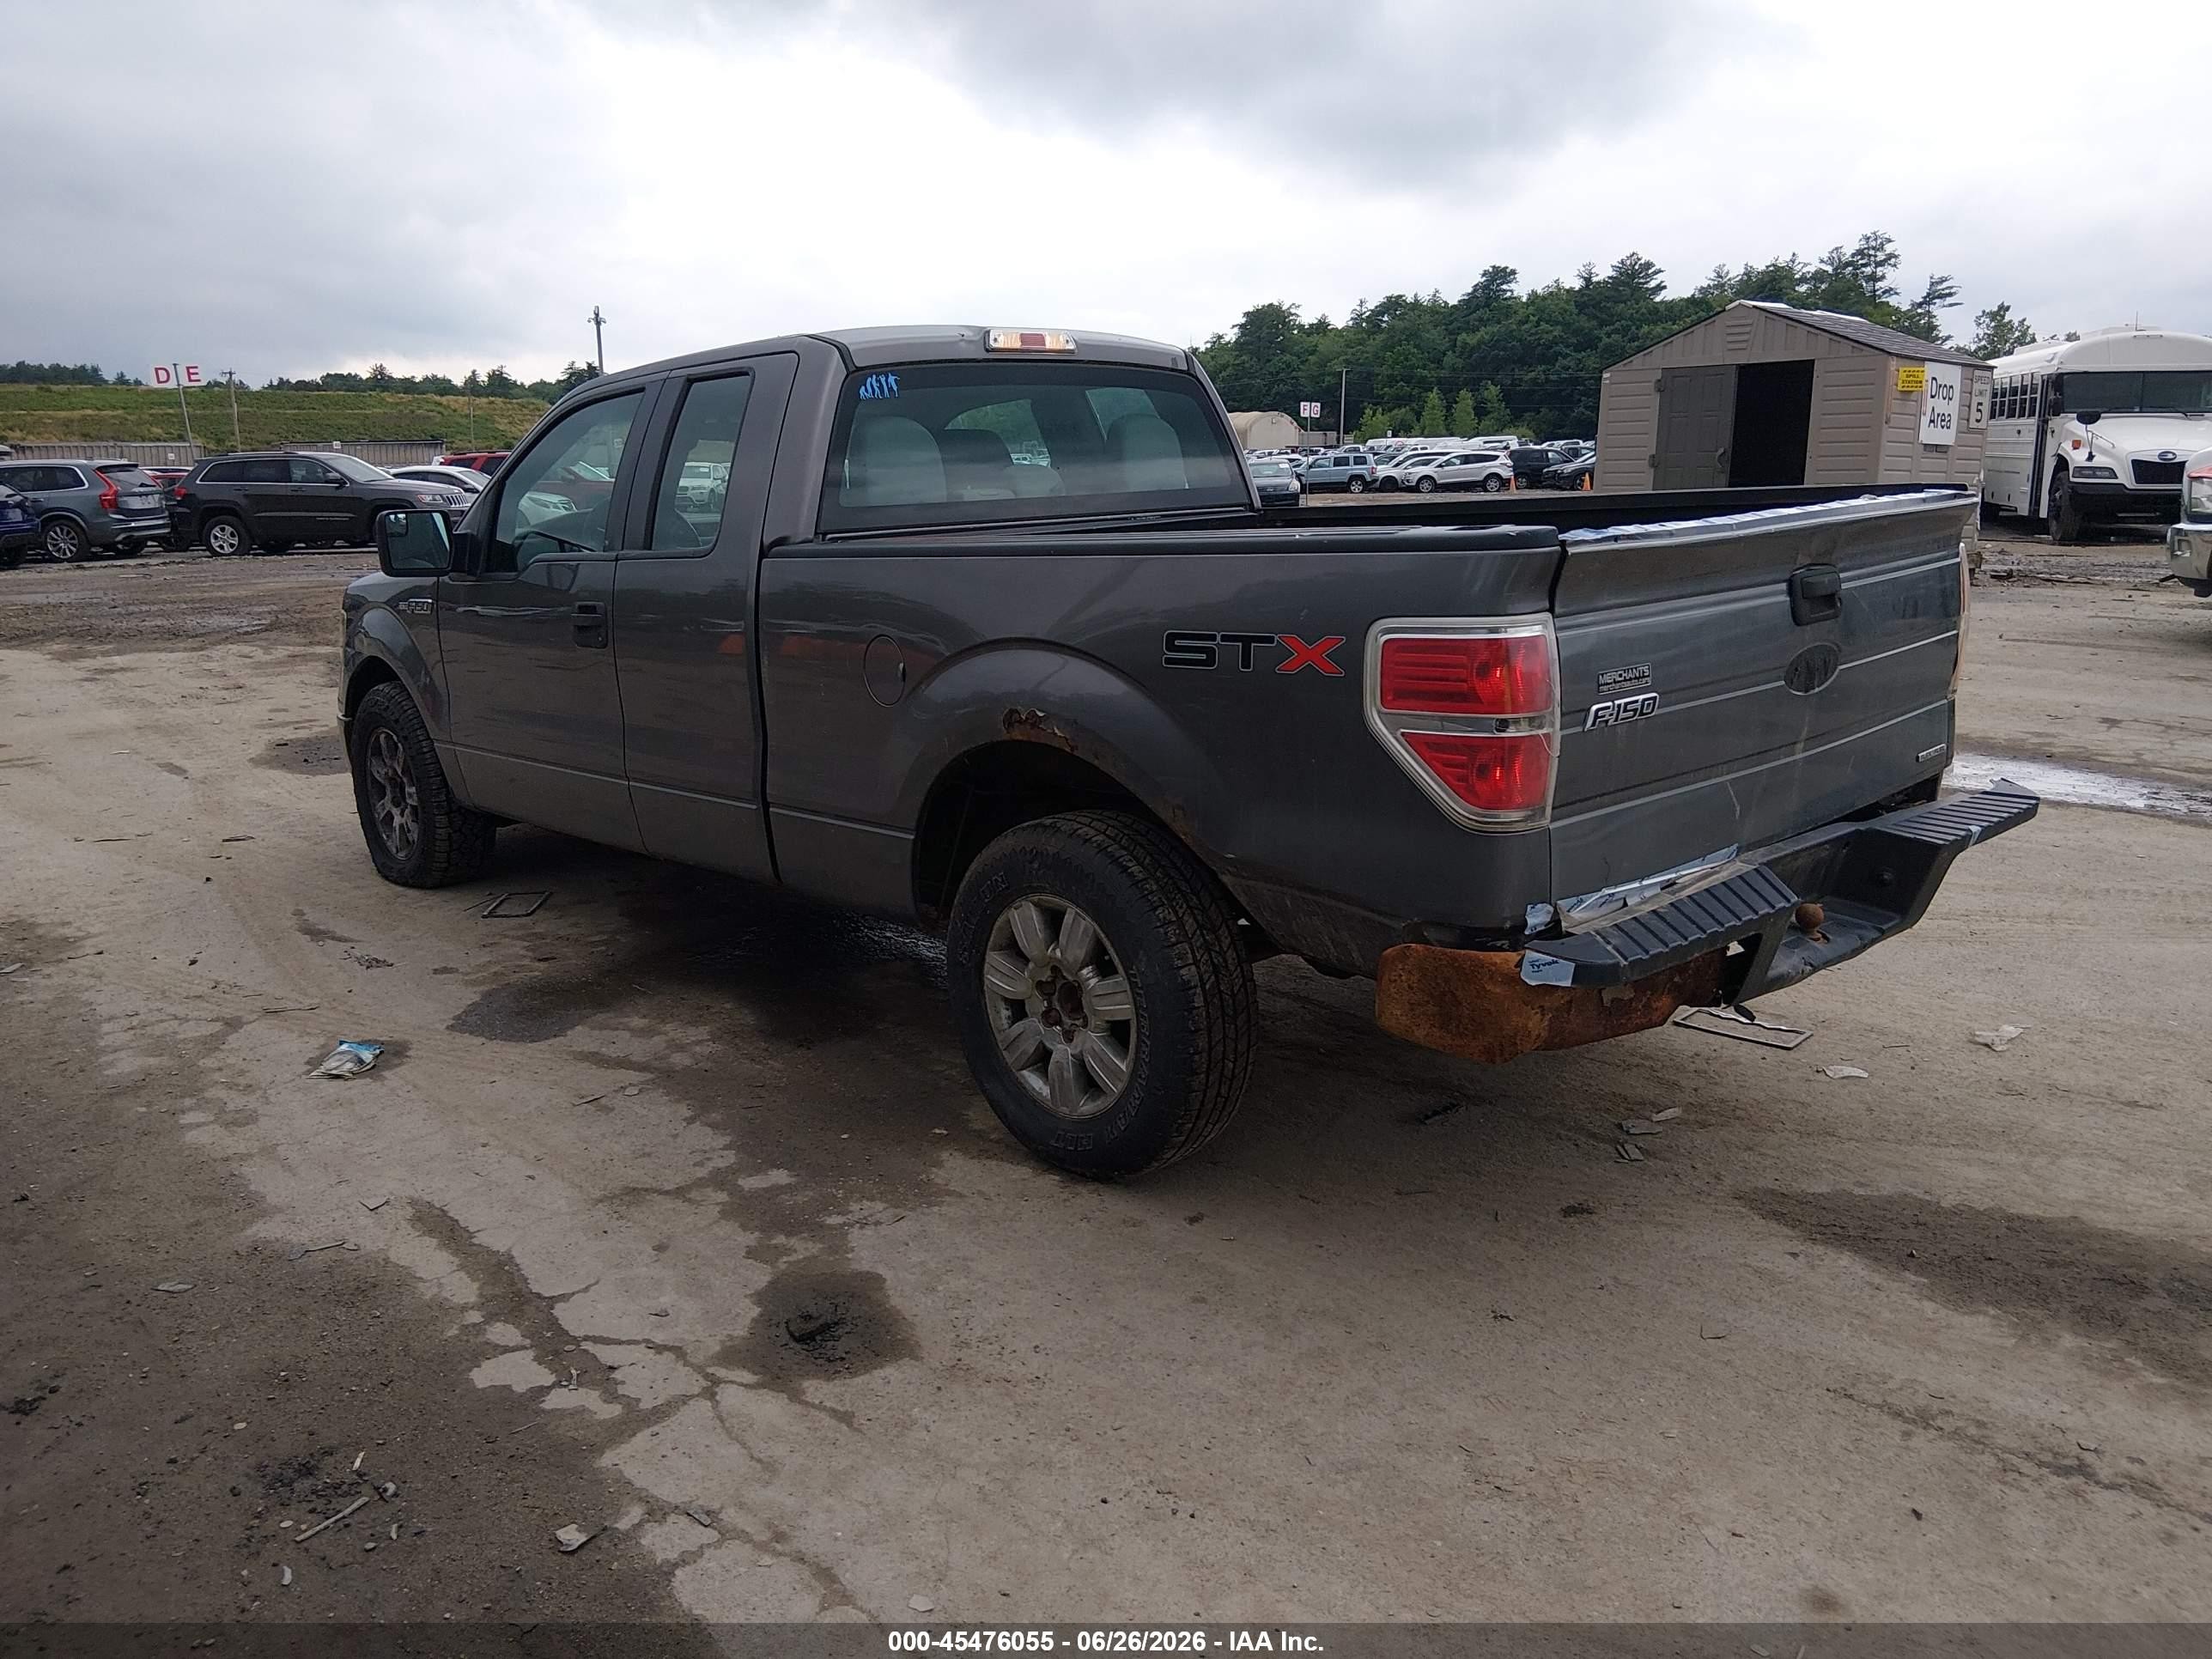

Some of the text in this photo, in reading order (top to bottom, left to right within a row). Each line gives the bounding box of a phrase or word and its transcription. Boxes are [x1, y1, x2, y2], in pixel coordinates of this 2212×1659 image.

[155, 368, 170, 384] D
[185, 366, 201, 382] E
[1973, 374, 1990, 385] SPEED
[1930, 376, 1954, 405] Drop
[1974, 387, 1988, 397] LIMIT
[1303, 404, 1308, 415] F
[1313, 404, 1319, 416] G
[1928, 406, 1952, 429] Area
[1975, 402, 1984, 423] 5
[1163, 630, 1346, 676] STX
[1599, 665, 1650, 684] MERCHANTS
[1584, 692, 1659, 732] F-150
